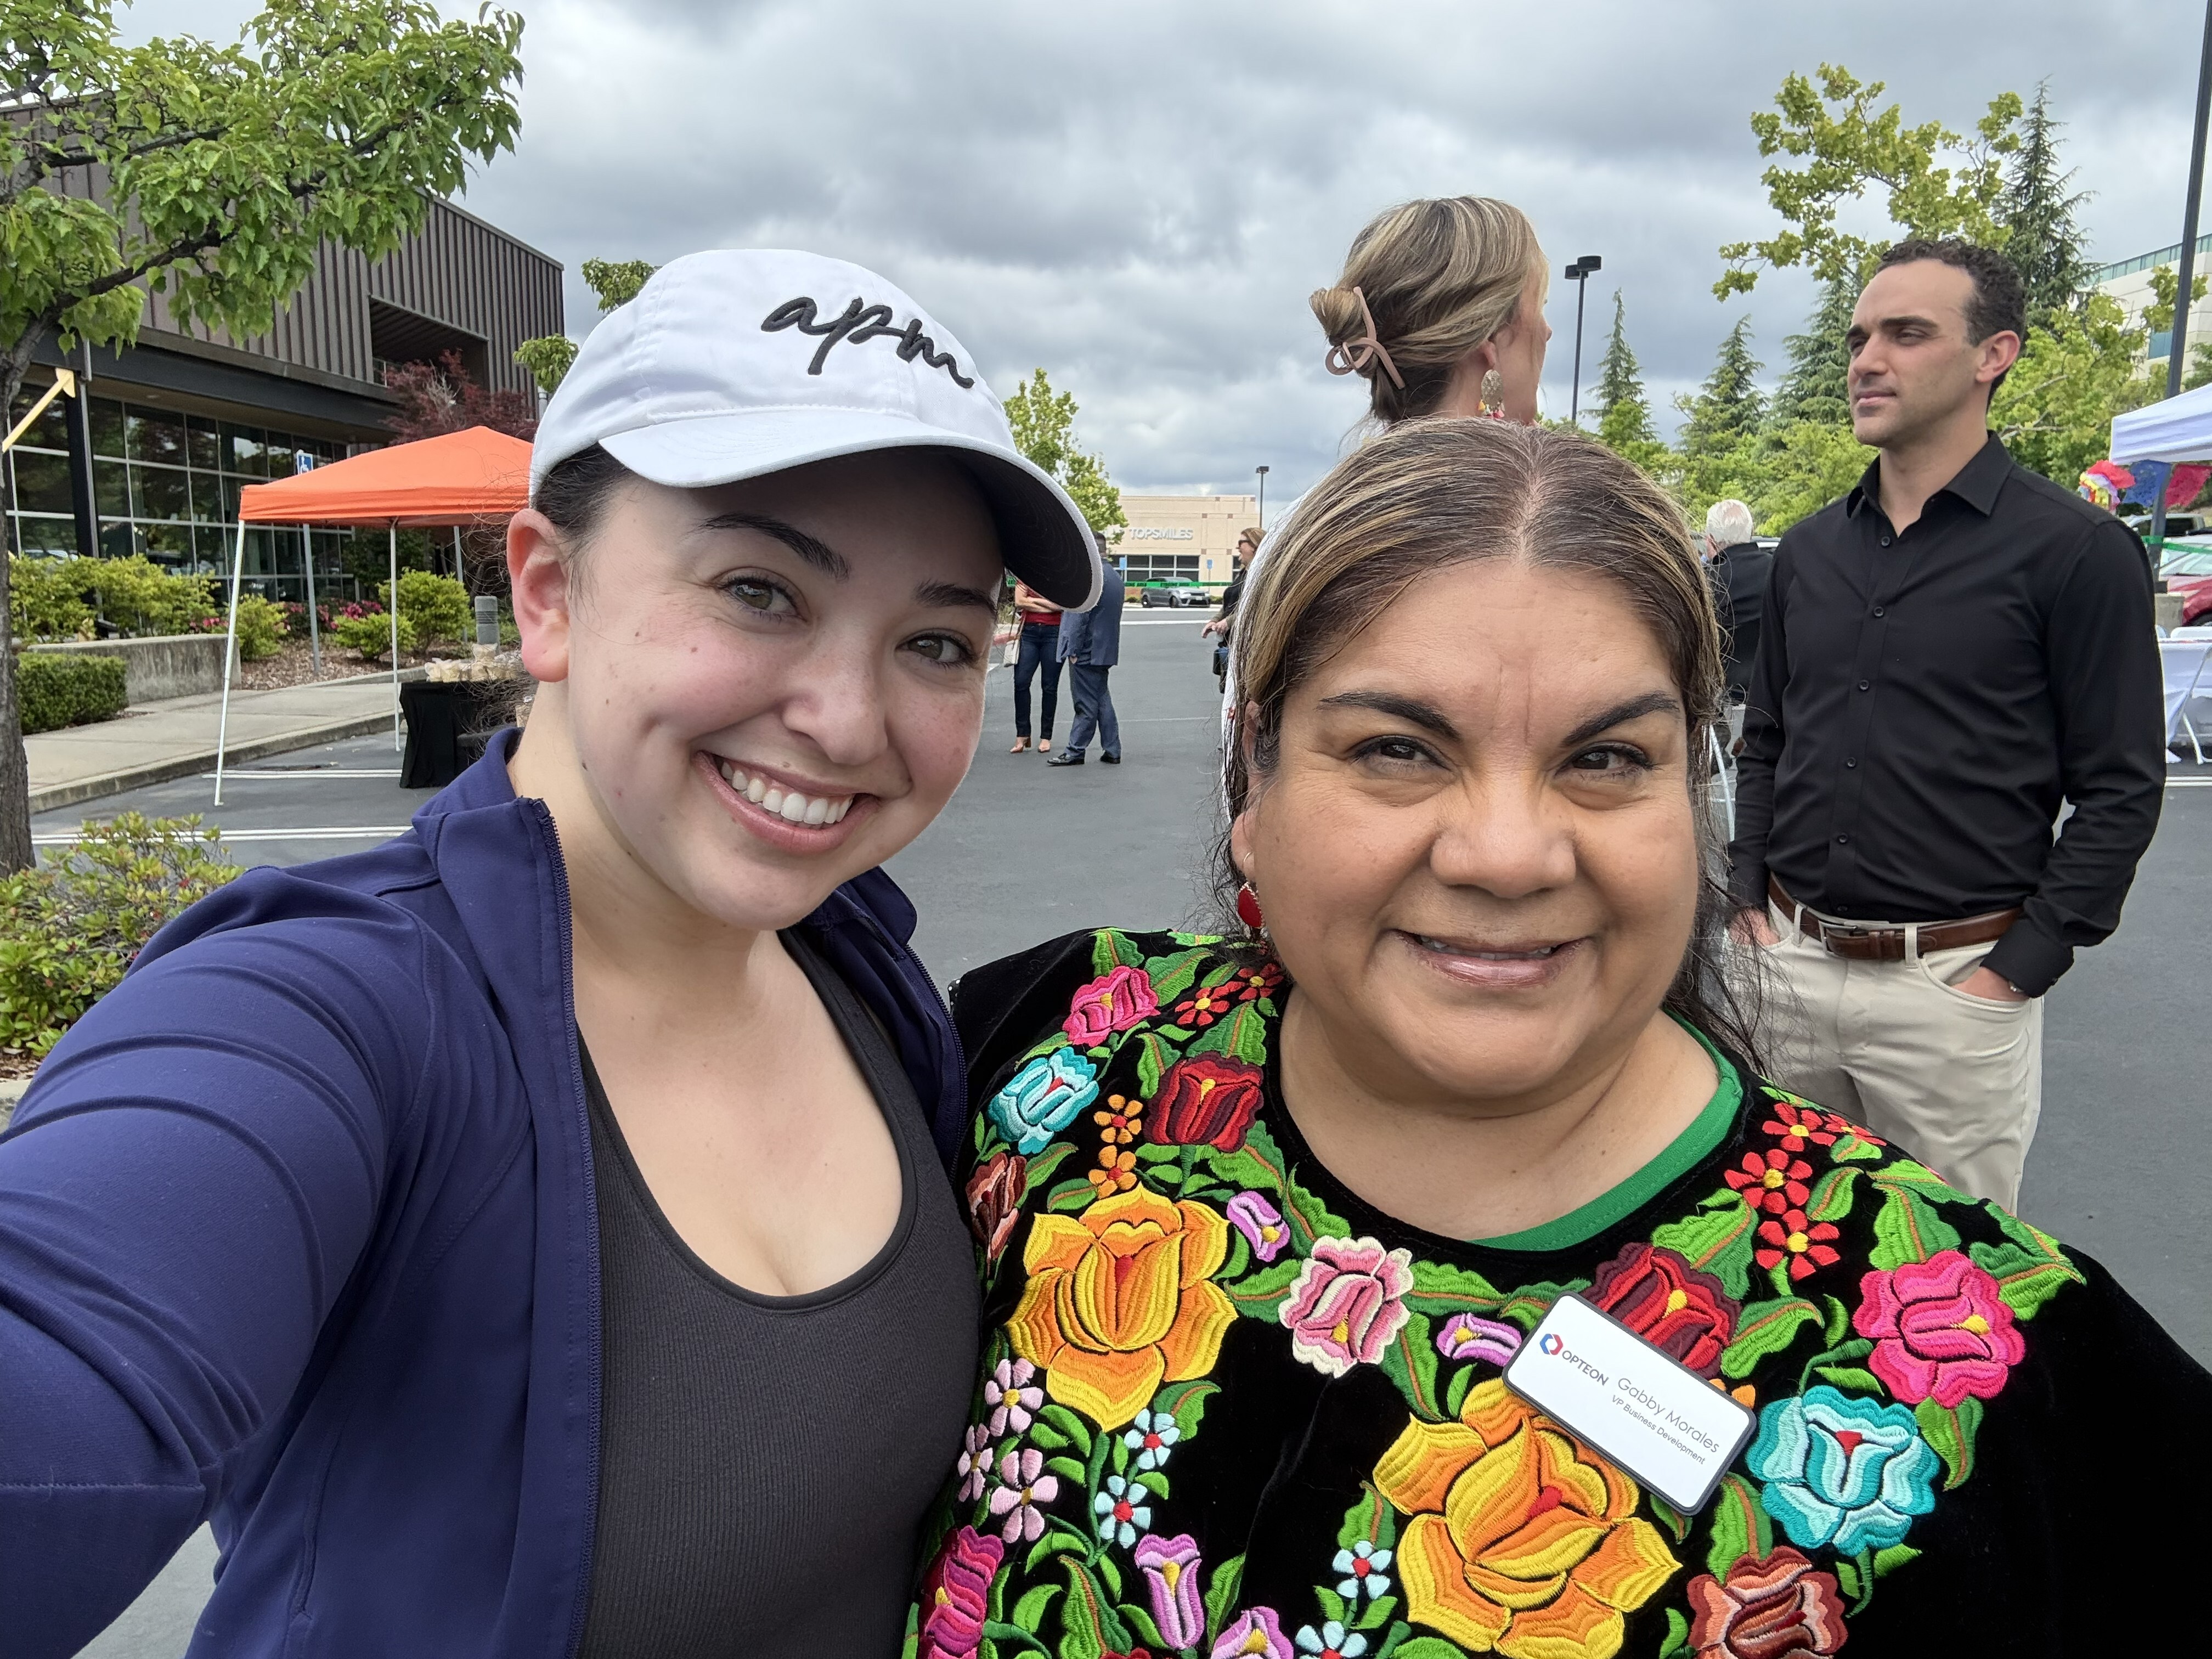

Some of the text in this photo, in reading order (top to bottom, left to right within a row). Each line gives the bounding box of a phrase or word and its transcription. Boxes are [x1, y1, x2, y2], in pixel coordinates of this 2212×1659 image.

[1562, 1350, 1609, 1386] OPTEON
[1612, 1395, 1706, 1465] VP Business Development
[1618, 1378, 1719, 1453] Gabby Morales
